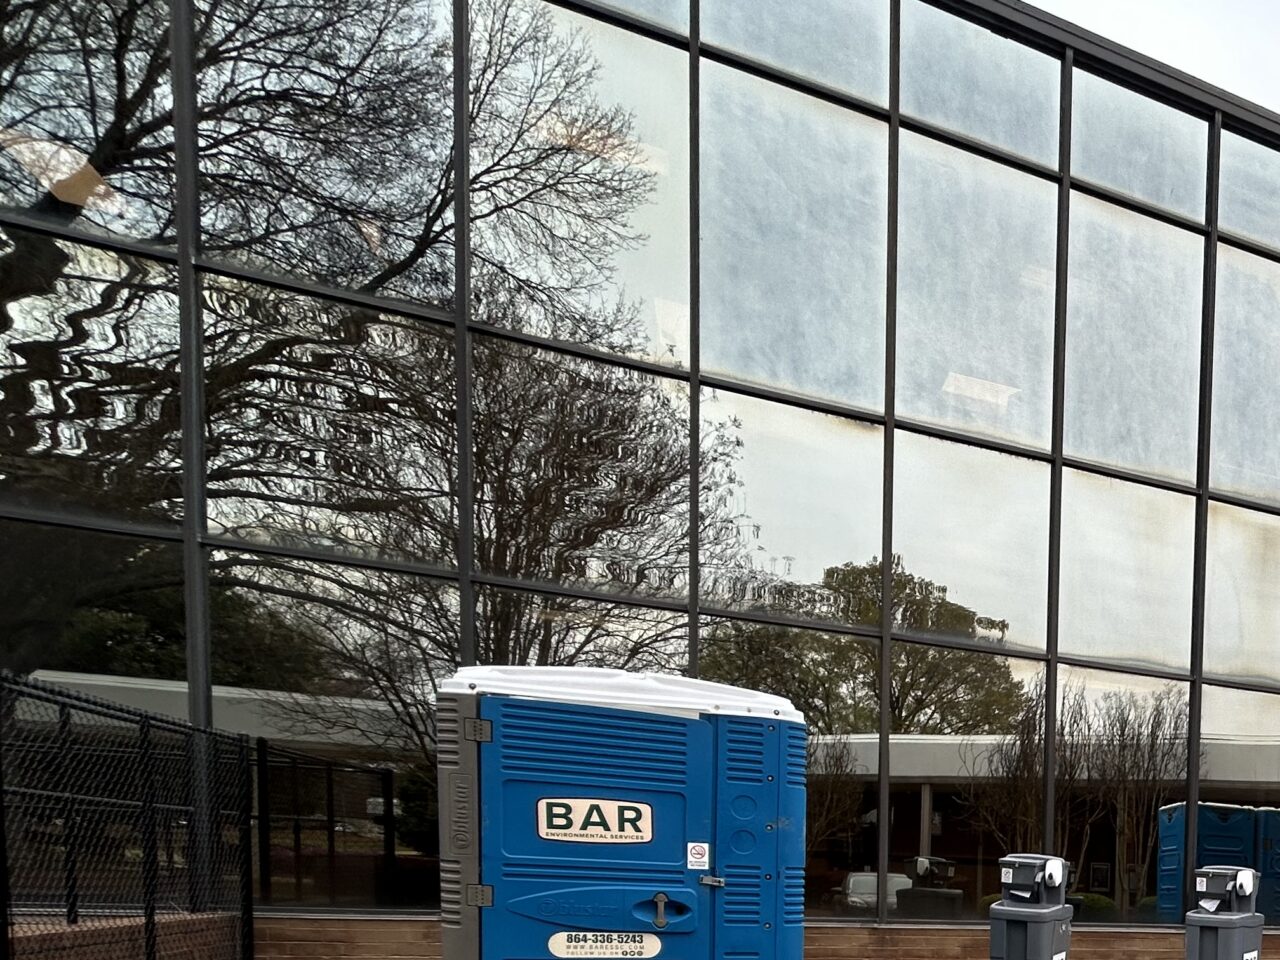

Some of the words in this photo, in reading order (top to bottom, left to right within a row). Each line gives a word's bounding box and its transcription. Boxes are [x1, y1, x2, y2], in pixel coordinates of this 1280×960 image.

[545, 801, 643, 833] BAR
[545, 831, 608, 840] ENVIRONMENTAL
[566, 933, 644, 944] 864-336-5243
